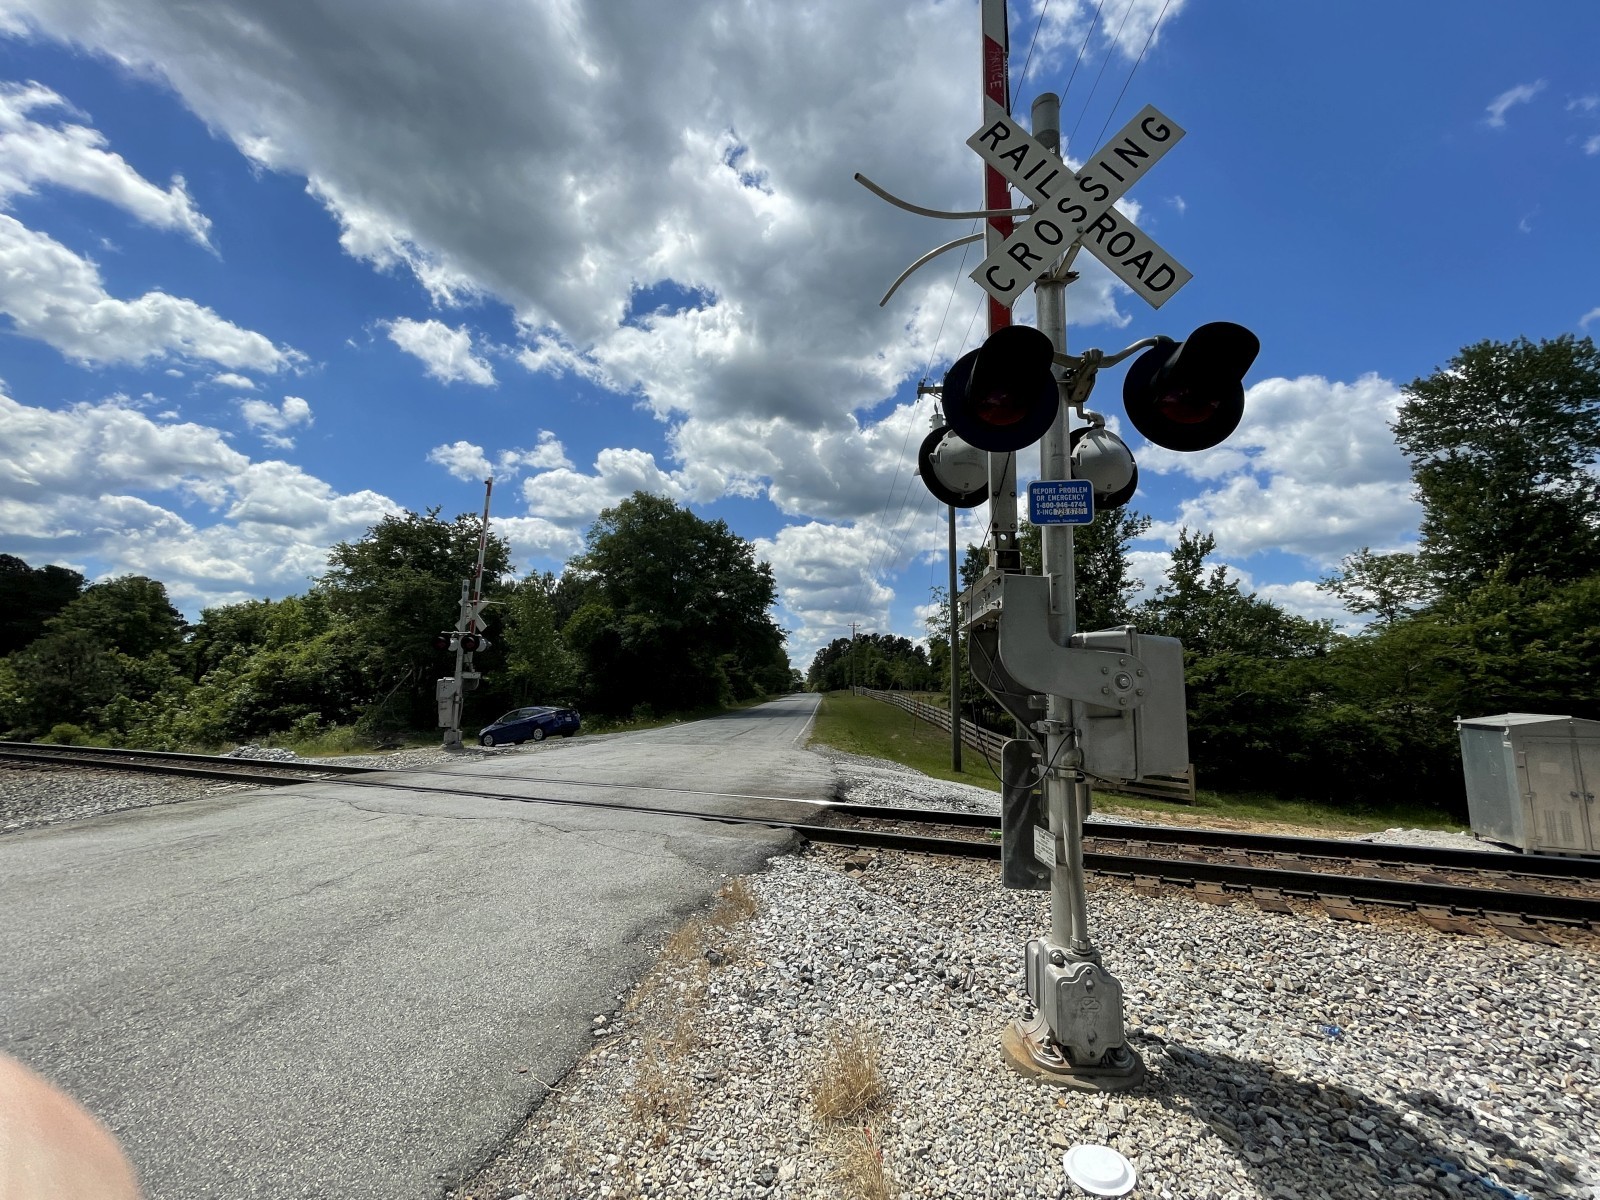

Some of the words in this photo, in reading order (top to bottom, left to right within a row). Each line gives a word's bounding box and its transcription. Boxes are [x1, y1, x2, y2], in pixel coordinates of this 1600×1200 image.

[979, 120, 1059, 200] RAIL
[1085, 211, 1176, 292] ROAD
[985, 116, 1171, 292] CROSSING
